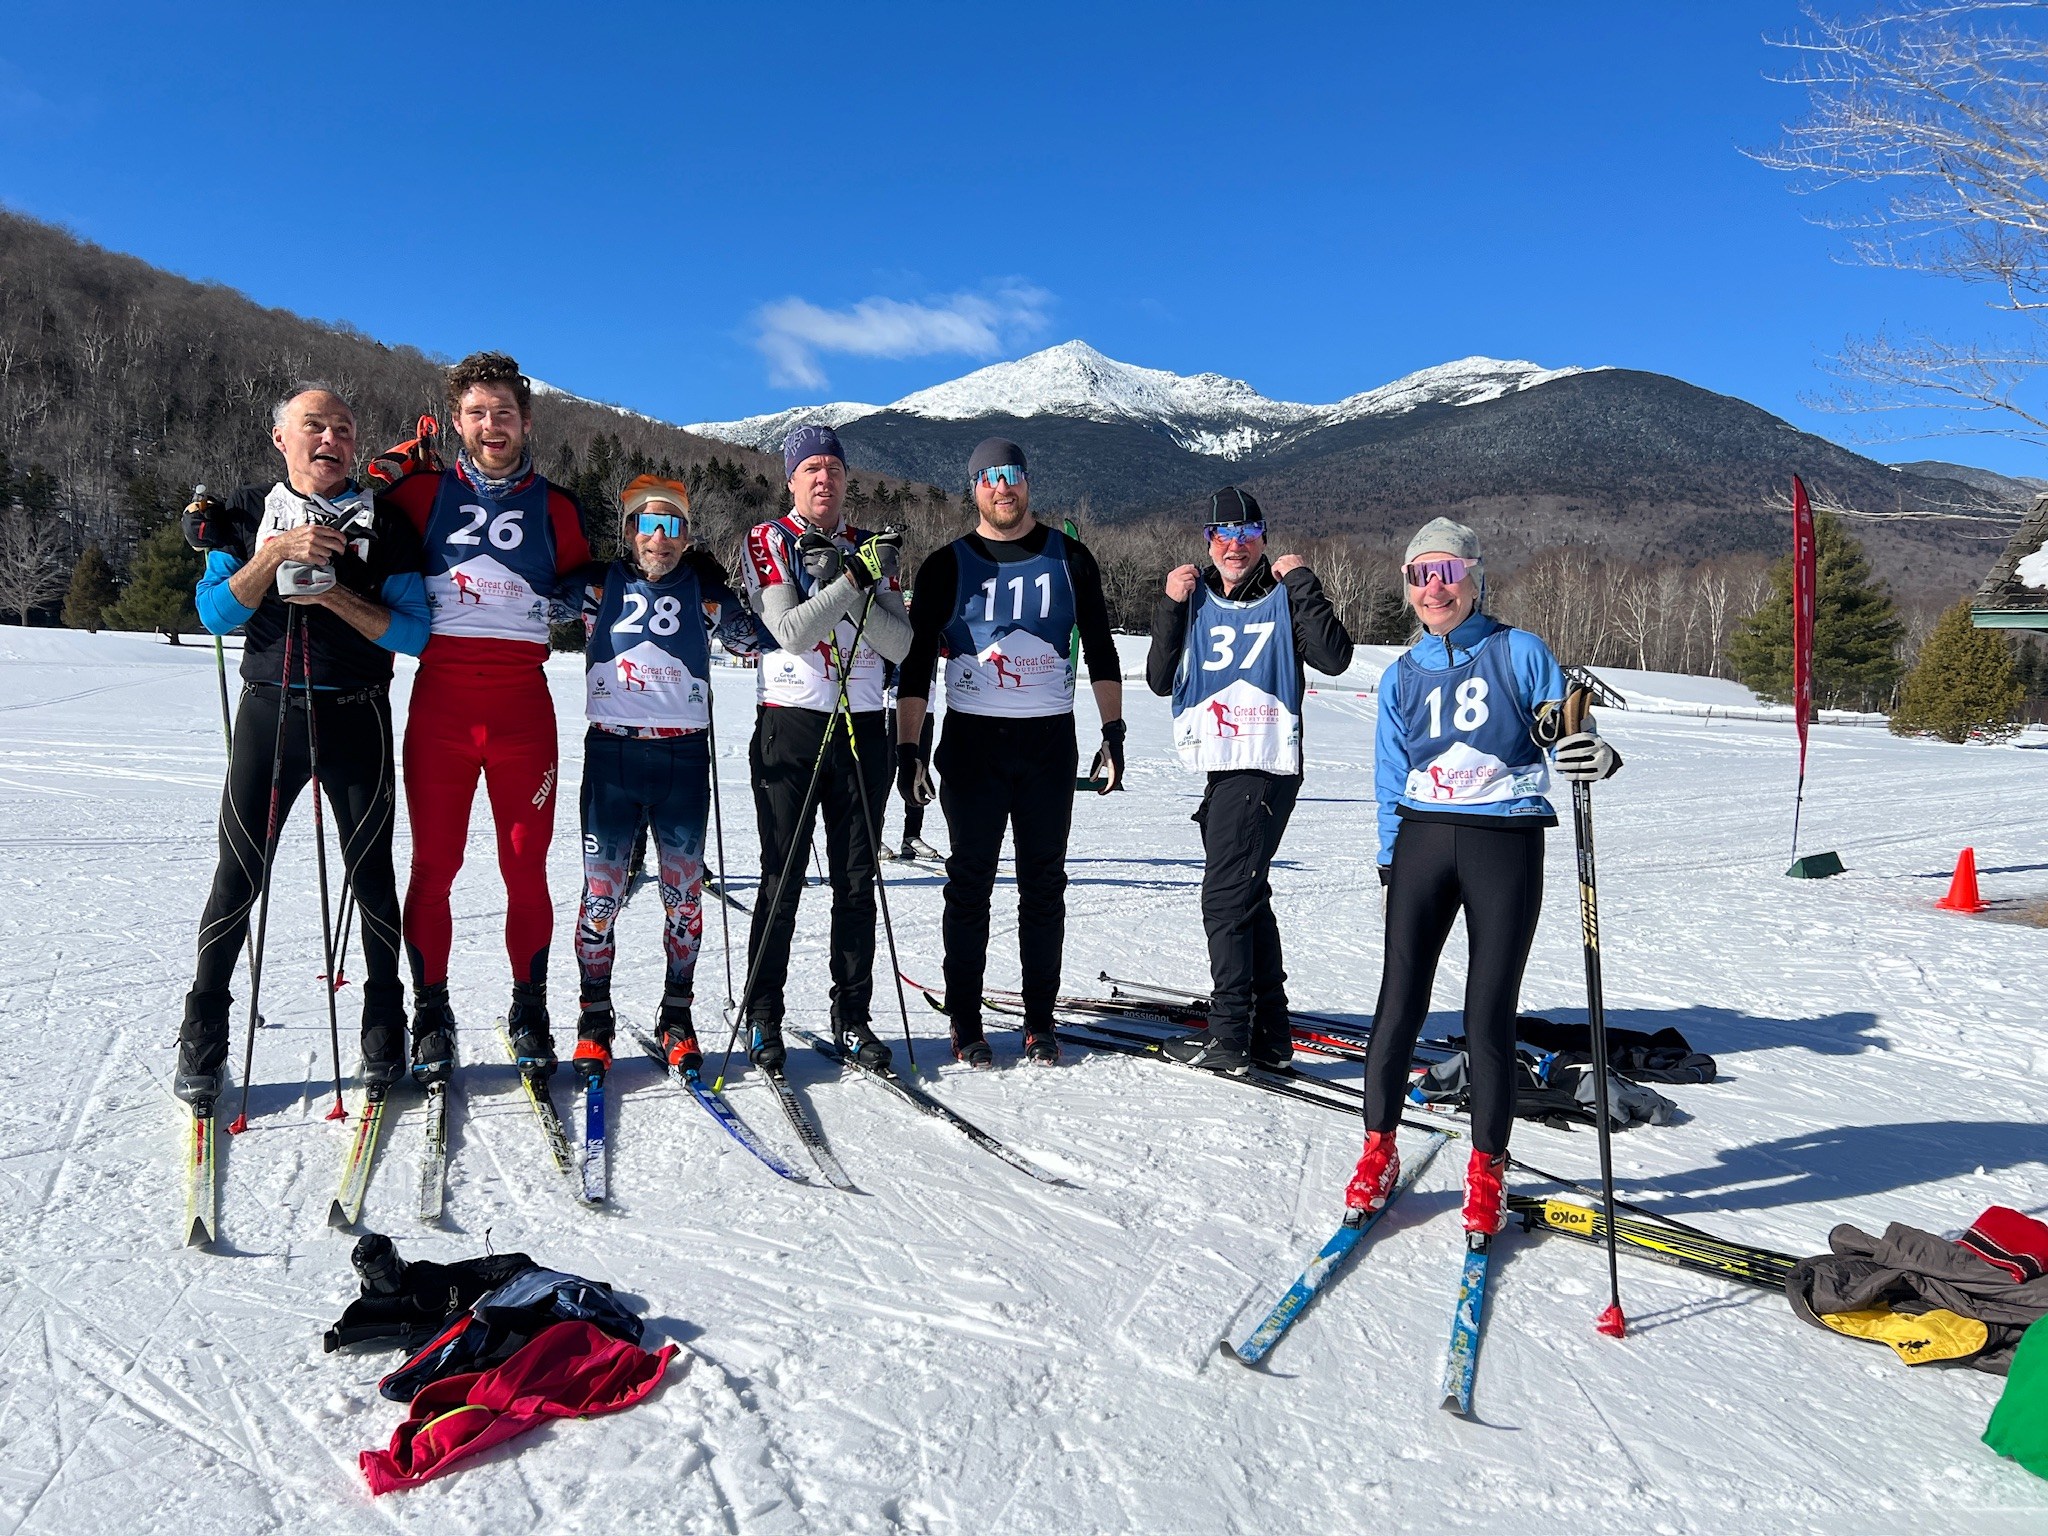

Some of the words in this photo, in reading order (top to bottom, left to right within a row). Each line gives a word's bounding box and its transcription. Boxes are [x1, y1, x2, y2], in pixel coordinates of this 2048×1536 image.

[446, 504, 524, 551] 26
[477, 578, 501, 589] Great
[504, 581, 523, 592] Glen
[981, 573, 1050, 621] 111
[612, 593, 681, 636] 28
[1202, 621, 1275, 671] 37
[841, 648, 862, 659] Grat
[1015, 656, 1039, 667] Great
[641, 665, 662, 675] Great
[665, 666, 681, 677] Glen
[1016, 665, 1056, 673] OUTFITTERS
[1234, 706, 1257, 717] Great
[1260, 705, 1279, 716] Glen
[1424, 677, 1490, 739] 18
[1447, 768, 1474, 780] Great
[1123, 1010, 1170, 1022] ROSSIGNOL
[1551, 1211, 1586, 1223] TOKO
